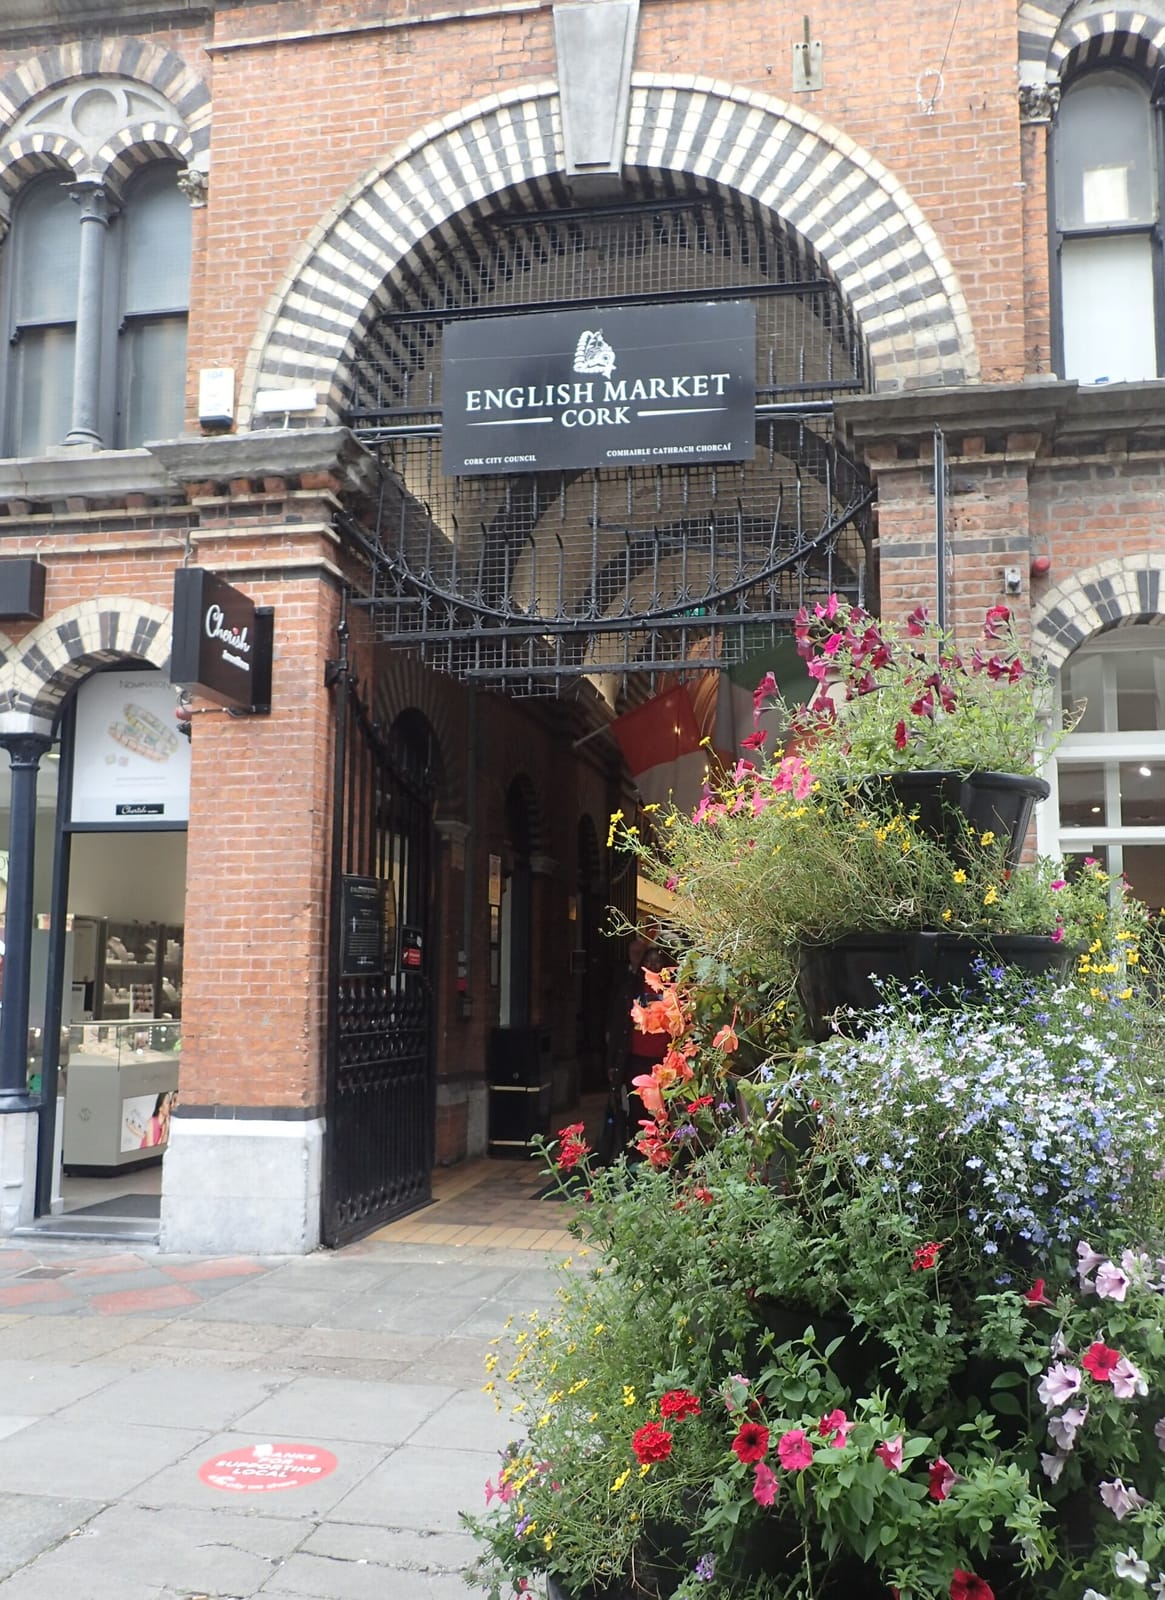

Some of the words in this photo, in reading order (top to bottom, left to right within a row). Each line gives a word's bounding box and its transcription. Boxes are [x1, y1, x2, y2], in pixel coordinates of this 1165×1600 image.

[465, 382, 594, 412] ENGLISH
[603, 373, 731, 402] MARKET
[561, 406, 631, 428] CORK
[606, 447, 651, 457] COMHAIRLE
[653, 445, 694, 455] CATHRACH
[696, 442, 732, 453] CHORCAÍ
[464, 457, 484, 466] CORK
[485, 456, 503, 465] CITY
[504, 454, 537, 463] COUNCIL
[205, 604, 251, 652] Cherish
[215, 1459, 322, 1473] SUPPORTING
[232, 1469, 288, 1478] LOCAL
